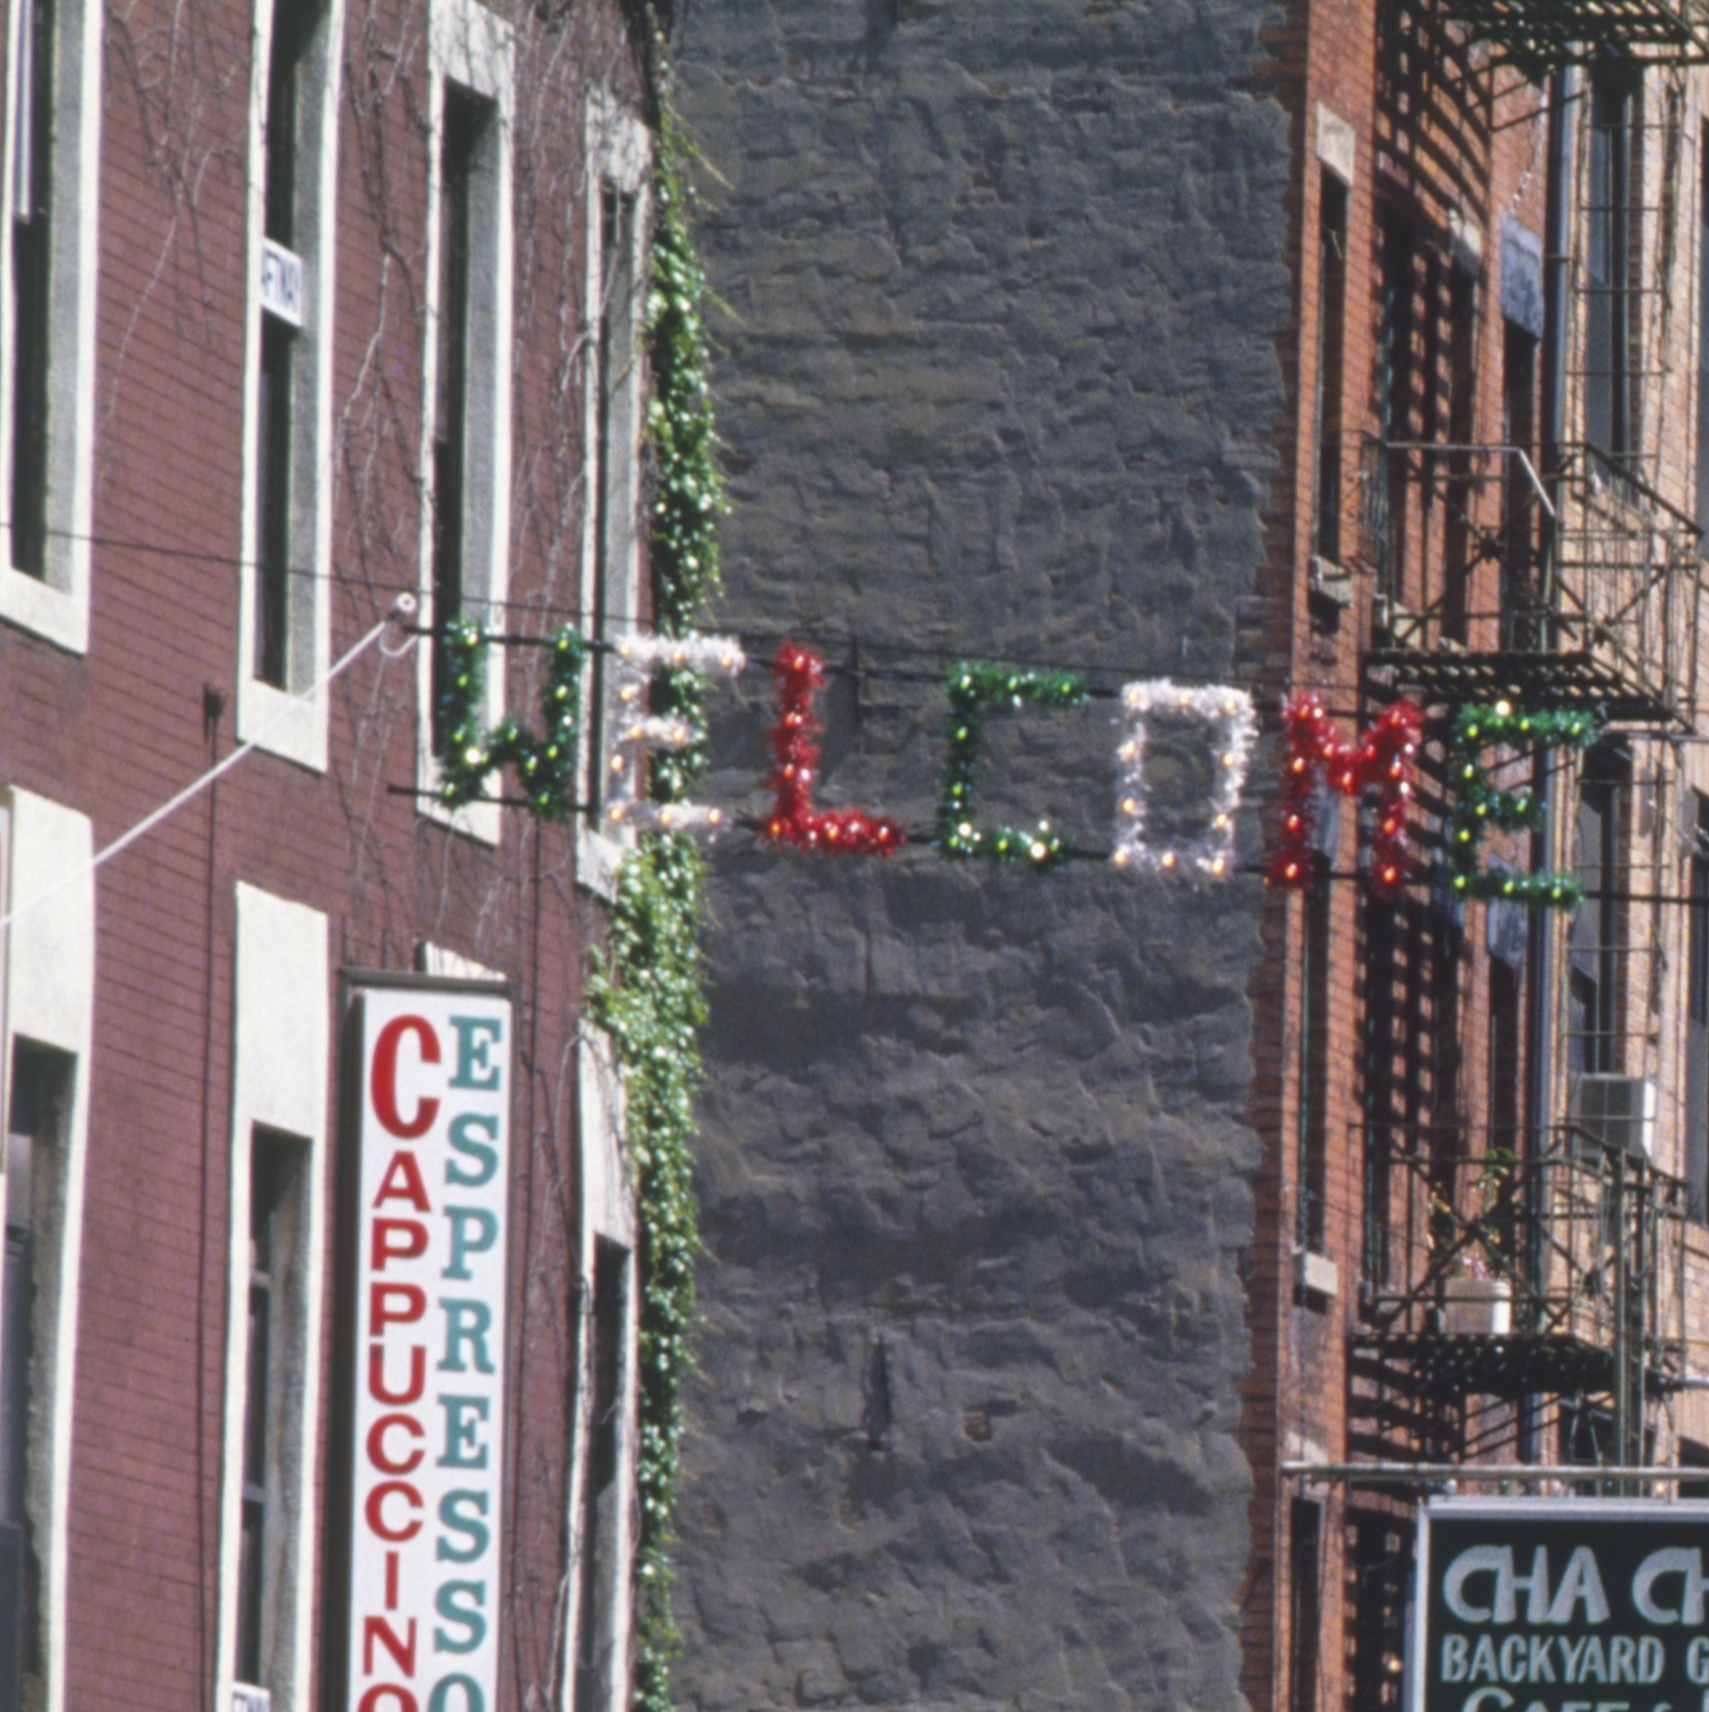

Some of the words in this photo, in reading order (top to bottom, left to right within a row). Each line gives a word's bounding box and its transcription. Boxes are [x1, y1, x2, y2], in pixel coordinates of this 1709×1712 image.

[435, 615, 1598, 910] WELCOME
[1442, 1544, 1610, 1627] CHA
[1441, 1636, 1665, 1685] BACKYARD
